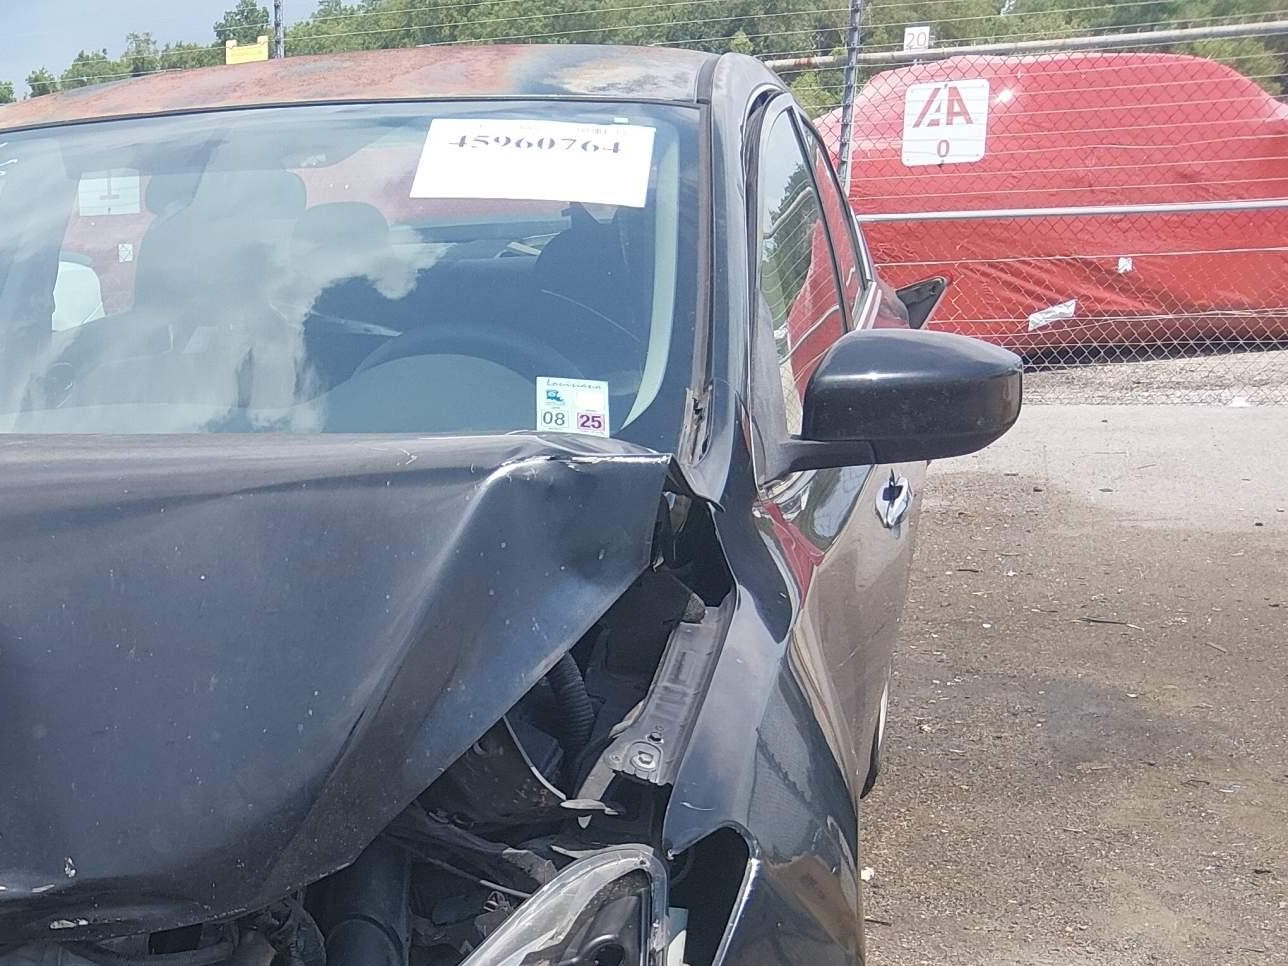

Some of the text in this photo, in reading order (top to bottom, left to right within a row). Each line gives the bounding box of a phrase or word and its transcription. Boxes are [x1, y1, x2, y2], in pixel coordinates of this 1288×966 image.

[905, 31, 927, 49] 20
[448, 134, 621, 153] 45960764
[936, 139, 950, 158] 0
[543, 411, 602, 429] 08 25
